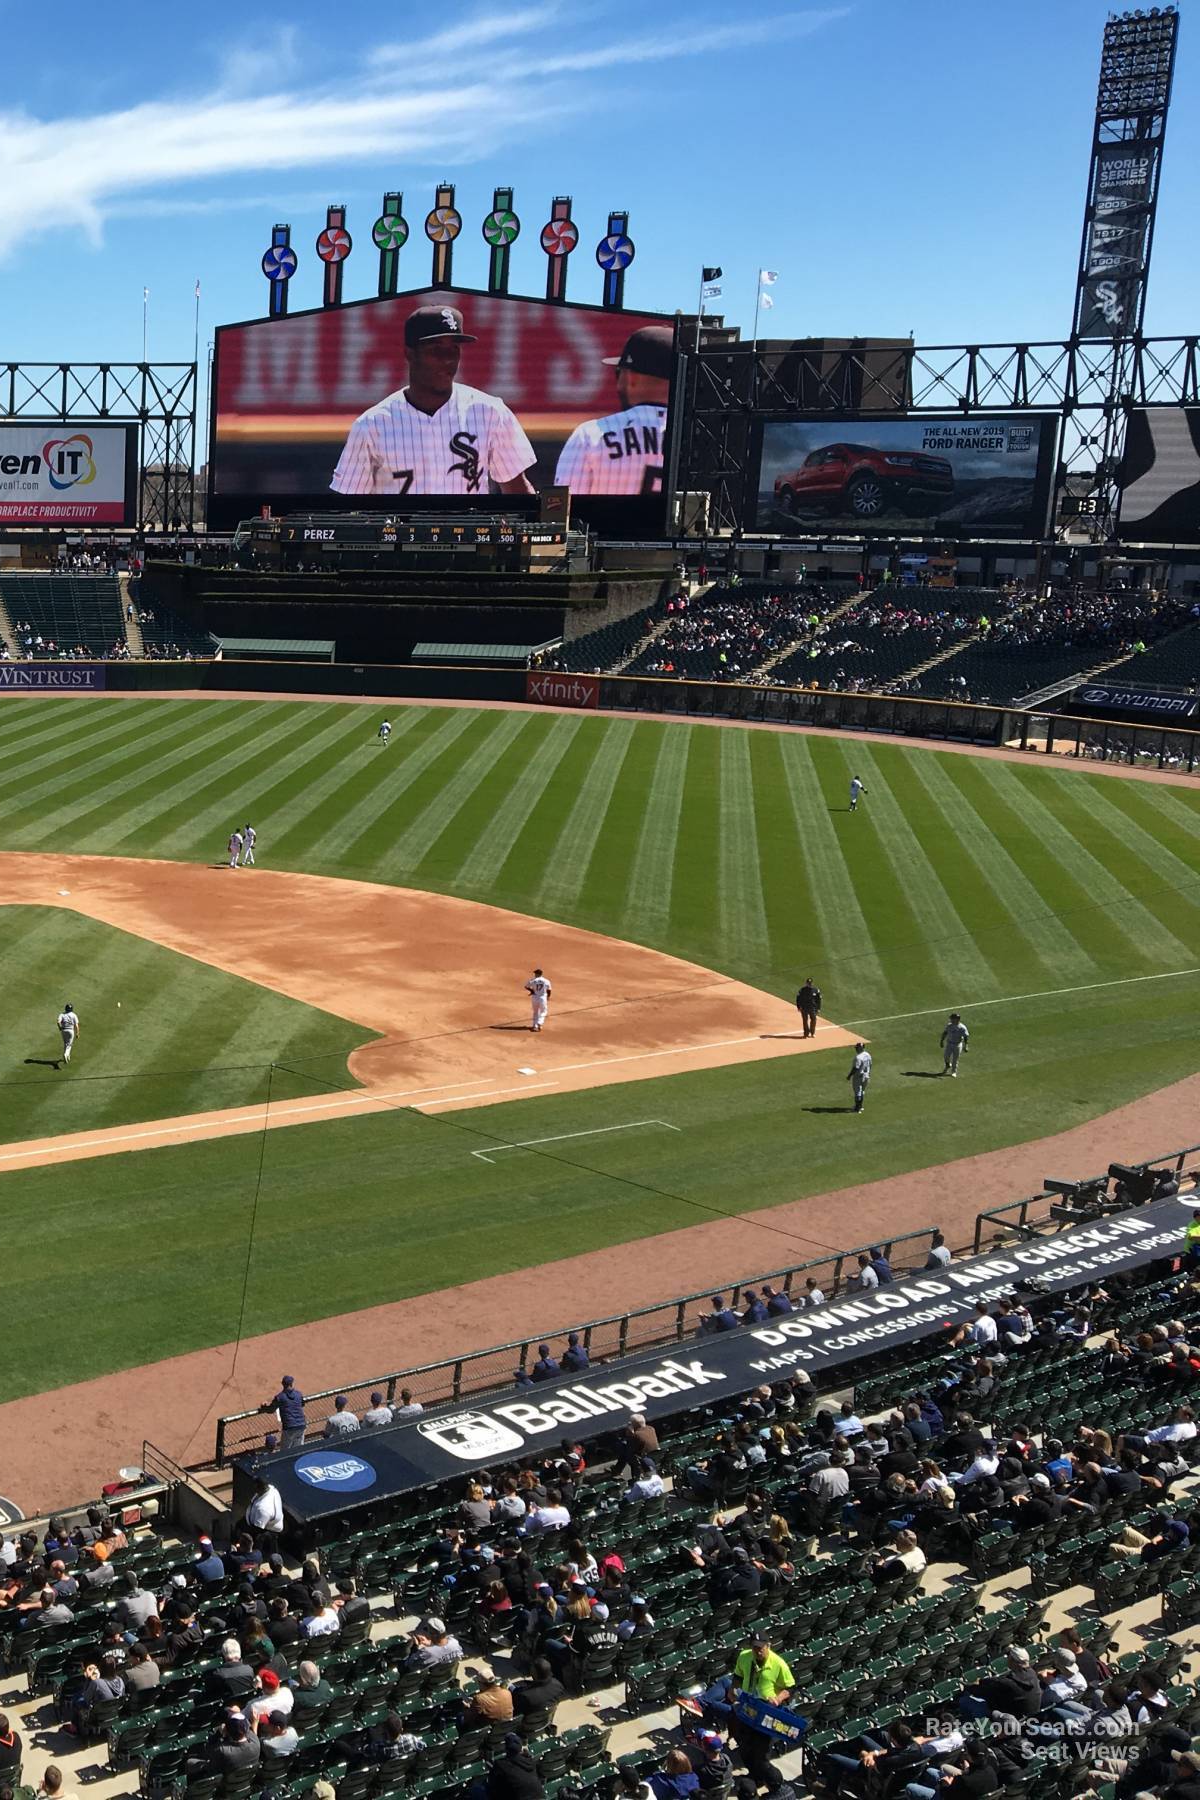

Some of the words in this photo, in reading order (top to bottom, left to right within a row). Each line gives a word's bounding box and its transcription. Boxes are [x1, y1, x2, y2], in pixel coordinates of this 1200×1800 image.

[1101, 157, 1149, 171] WORLD
[1100, 167, 1148, 181] SERIES
[1099, 178, 1146, 189] CHAMPIONS
[1098, 200, 1128, 209] 2005
[1095, 229, 1125, 238] 1917
[924, 428, 940, 436] THE
[942, 427, 980, 436] ALL-NEW
[983, 426, 1005, 435] 2019
[603, 420, 668, 460] SÁN
[922, 438, 953, 449] FORD
[955, 437, 1004, 449] RANGER
[57, 451, 83, 475] IT
[39, 505, 98, 517] PRODUCTIVITY
[288, 529, 295, 540] 7
[304, 529, 335, 540] PEREZ
[381, 534, 397, 542] .300
[498, 534, 514, 542] .500
[529, 677, 594, 706] xfinity
[752, 690, 779, 702] THE
[1110, 693, 1188, 711] HYUNDAI
[750, 1280, 951, 1346] DOWNLOAD
[948, 1260, 1020, 1288] AND
[1014, 1217, 1156, 1265] CHECK-IN
[749, 1348, 817, 1373] MAPS
[822, 1302, 957, 1351] CONCESSIONS
[963, 1265, 1083, 1306] EXPENCES
[1077, 1260, 1098, 1271] &
[1097, 1246, 1138, 1265] SEAT
[493, 1360, 728, 1436] Ballpark
[422, 1412, 476, 1431] BALLPARK
[298, 1460, 365, 1483] RAYS
